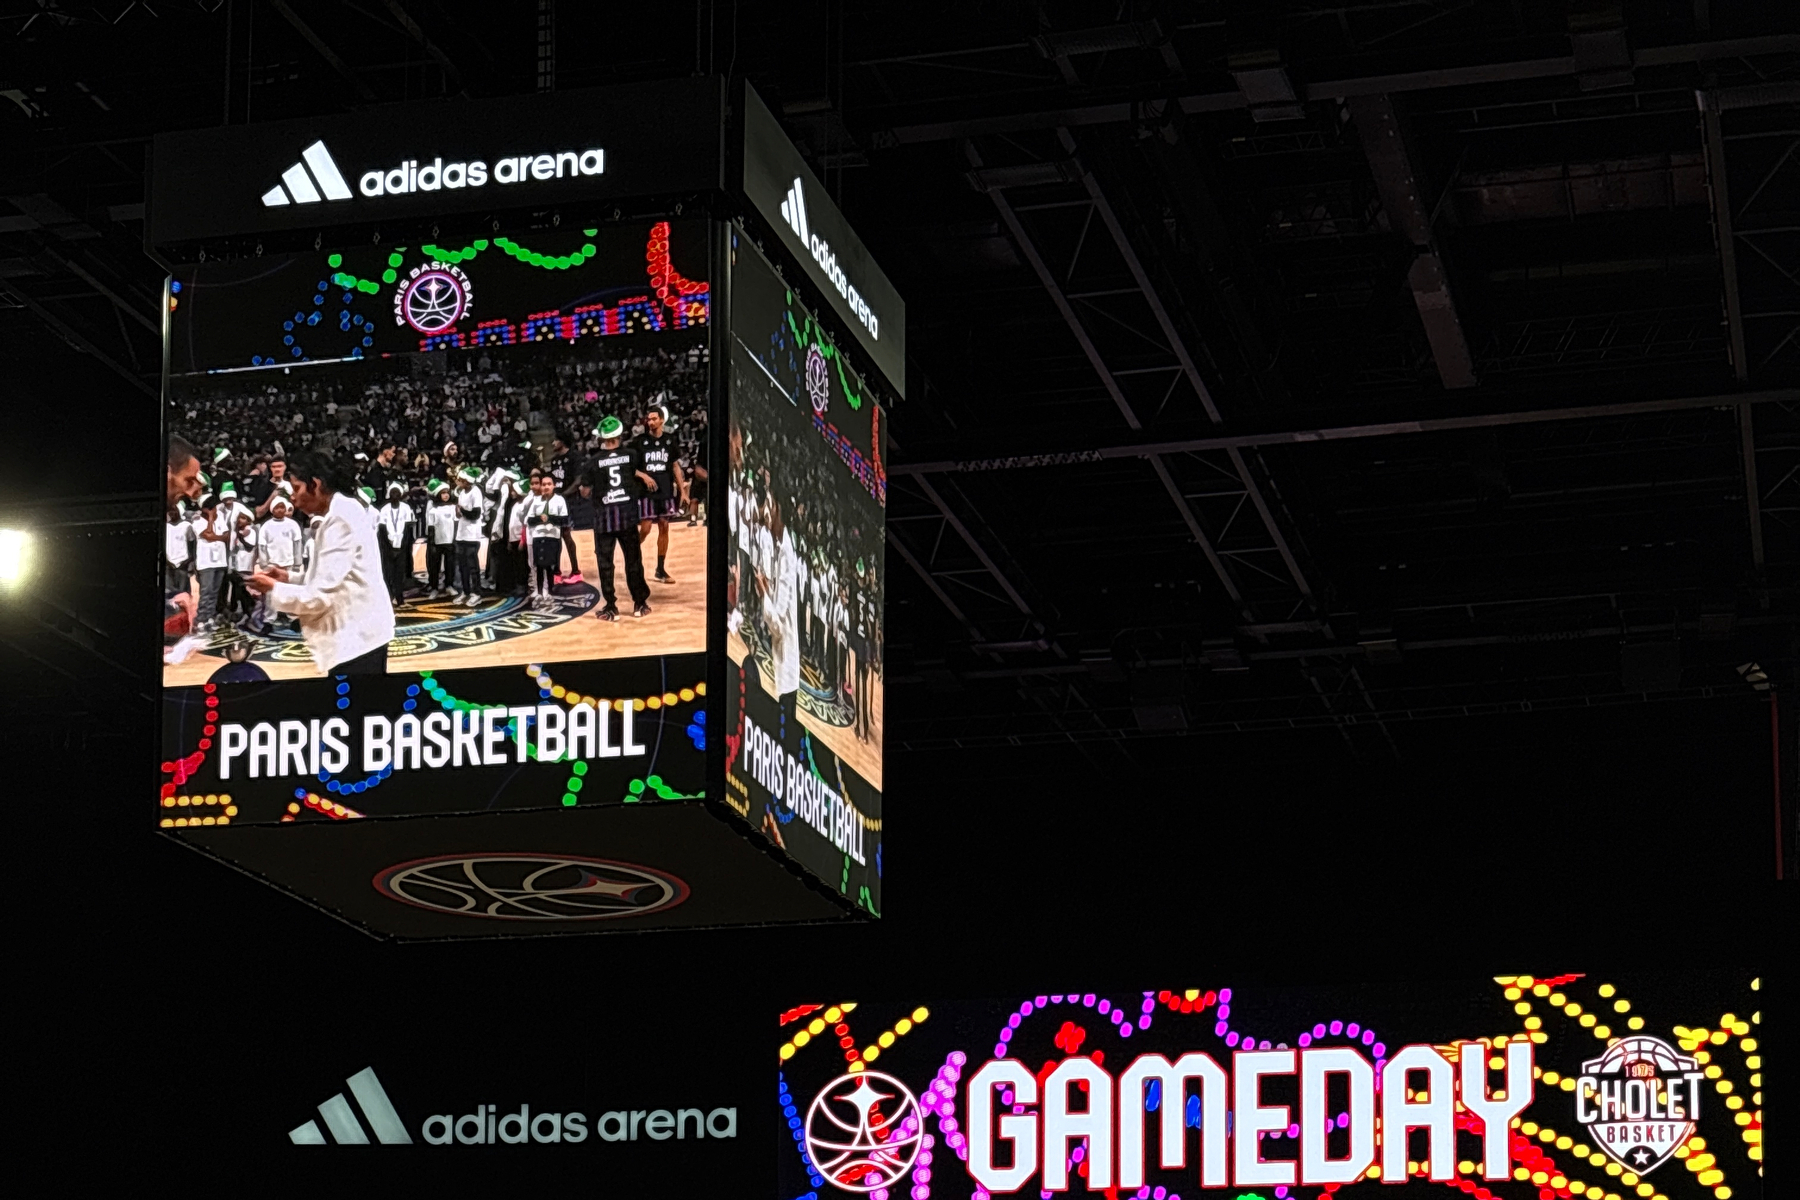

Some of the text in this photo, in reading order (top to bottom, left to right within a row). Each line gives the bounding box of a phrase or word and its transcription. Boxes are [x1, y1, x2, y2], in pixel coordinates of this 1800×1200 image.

[360, 149, 604, 197] adidas arena
[394, 261, 473, 327] PARIS BASKETBALL
[811, 233, 878, 341] adidas arena
[609, 465, 621, 487] 5
[645, 447, 668, 463] PARIS
[220, 700, 645, 779] PARIS BASKETBALL
[744, 715, 866, 867] PARIS BASKETBALL
[1625, 1065, 1655, 1077] 1975
[967, 1041, 1534, 1192] GAMEDAY
[1577, 1073, 1704, 1123] CHOLET
[422, 1104, 737, 1145] adidas arena
[1607, 1125, 1676, 1143] BASKET
